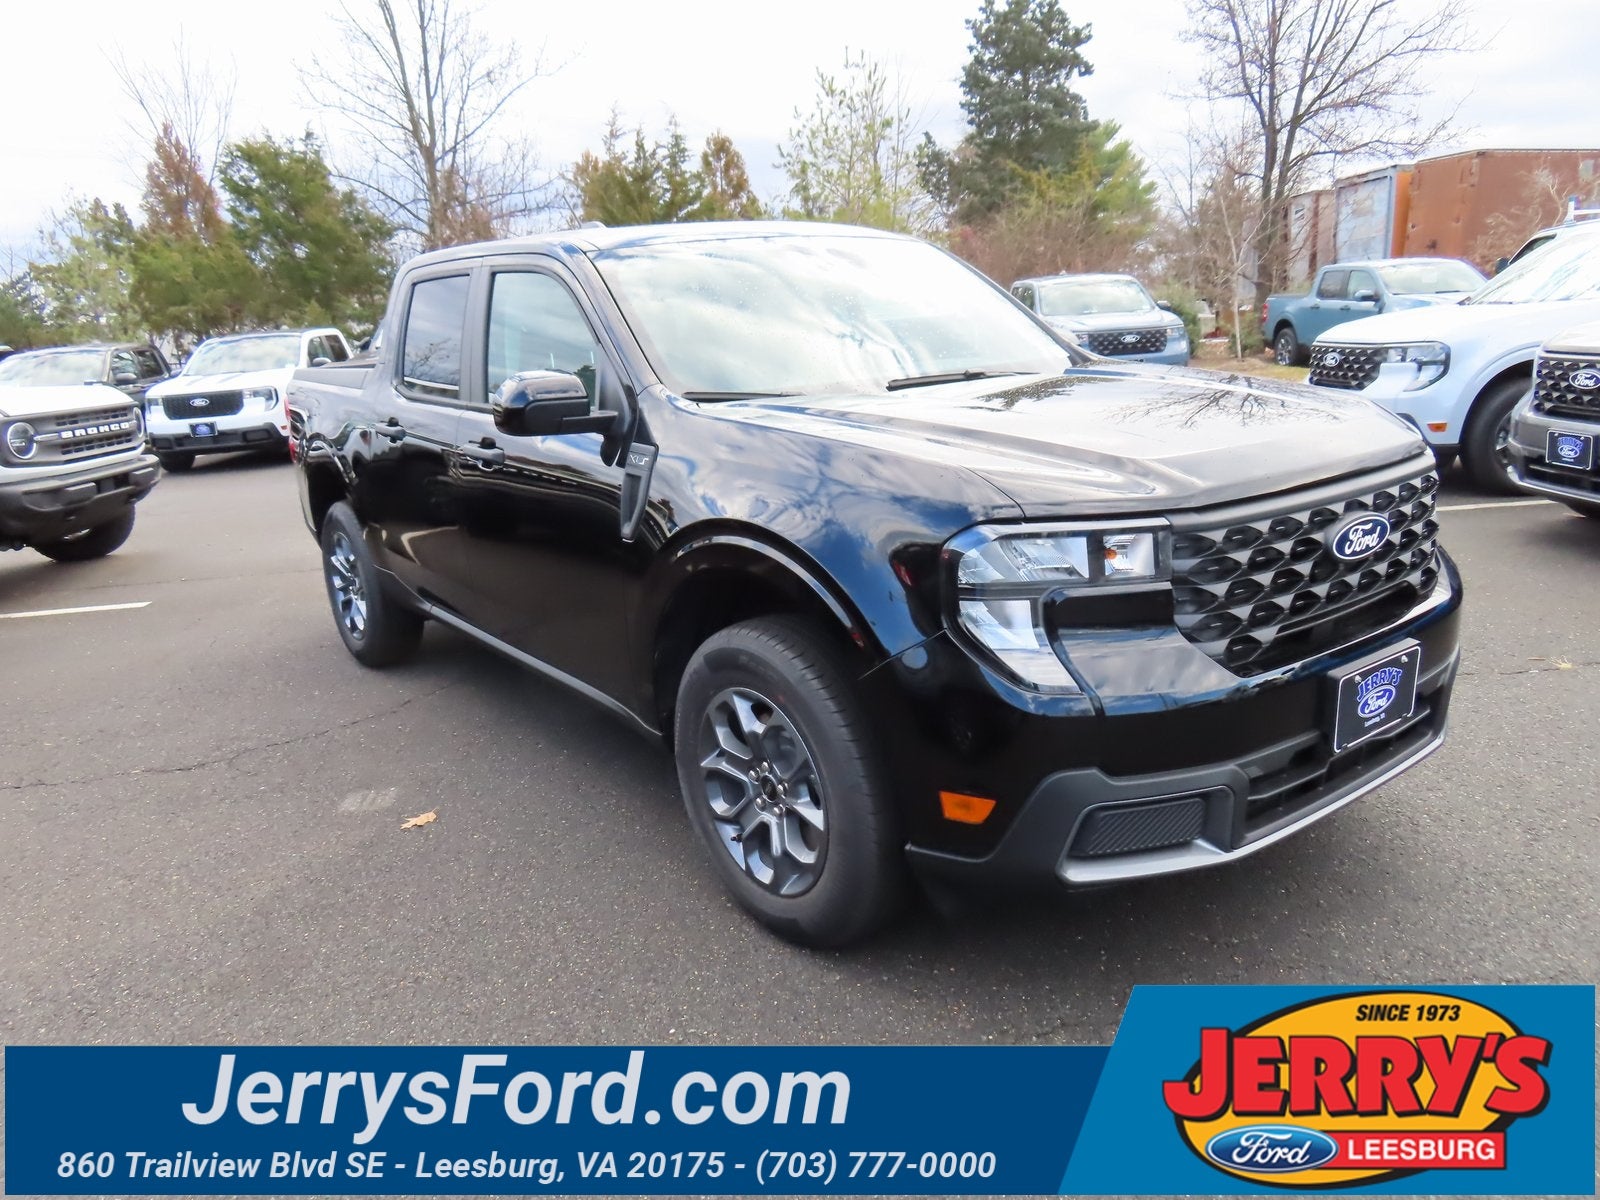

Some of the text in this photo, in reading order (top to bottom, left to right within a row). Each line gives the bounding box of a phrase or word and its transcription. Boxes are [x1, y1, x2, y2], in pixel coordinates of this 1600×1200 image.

[1574, 373, 1596, 387] Ford
[60, 422, 130, 439] BRONCO
[1344, 522, 1381, 555] Ford
[1364, 690, 1390, 714] Ford
